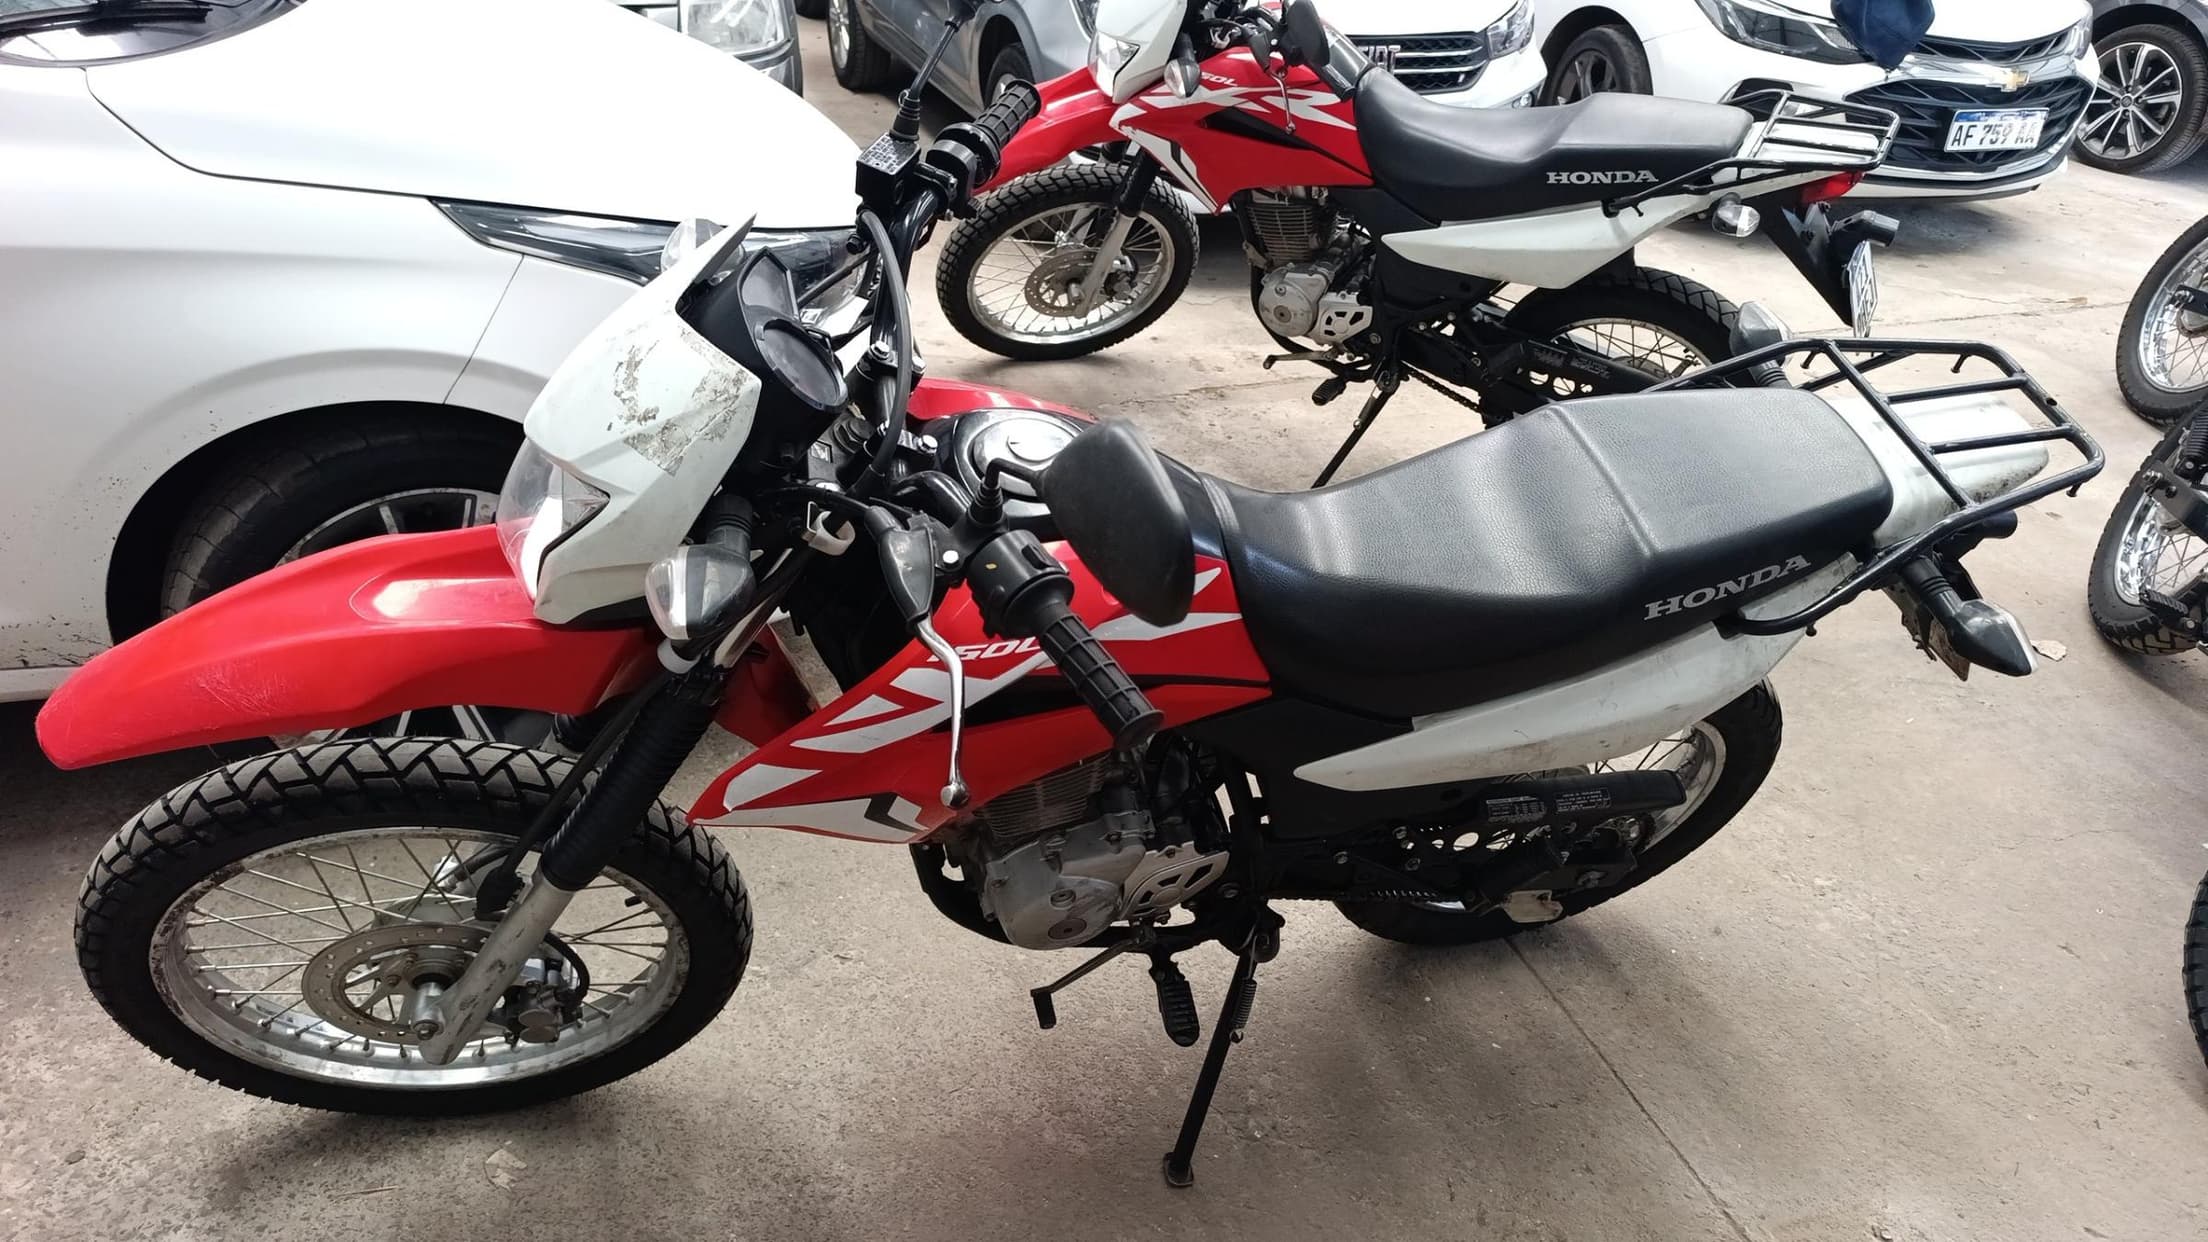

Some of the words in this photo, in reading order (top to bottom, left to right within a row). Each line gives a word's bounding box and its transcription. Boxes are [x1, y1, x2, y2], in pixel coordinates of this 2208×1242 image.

[1201, 71, 1239, 87] 50L
[1951, 124, 1978, 147] AF
[1979, 122, 2014, 146] 759
[1546, 169, 1659, 185] HONDA
[1644, 554, 1812, 620] HONDA
